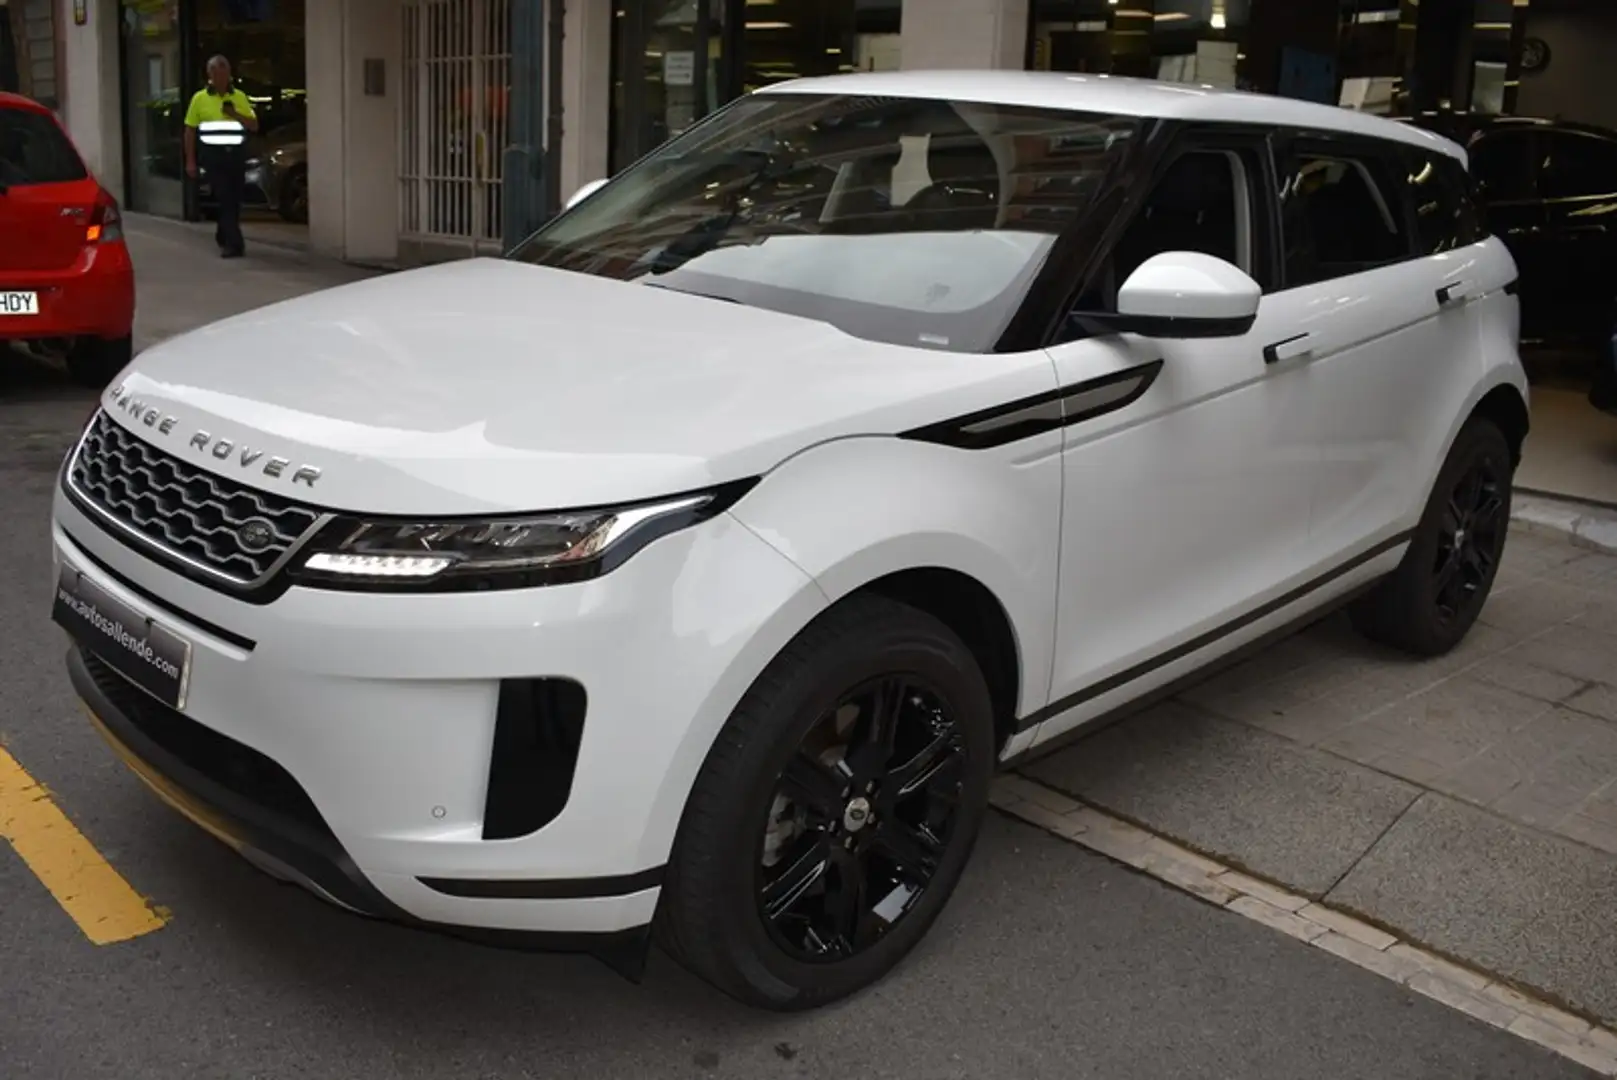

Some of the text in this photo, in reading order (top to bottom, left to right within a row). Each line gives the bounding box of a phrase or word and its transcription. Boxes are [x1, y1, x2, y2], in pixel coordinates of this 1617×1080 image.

[109, 385, 322, 487] RANGE ROVER
[59, 588, 179, 679] www.autosallende.com
